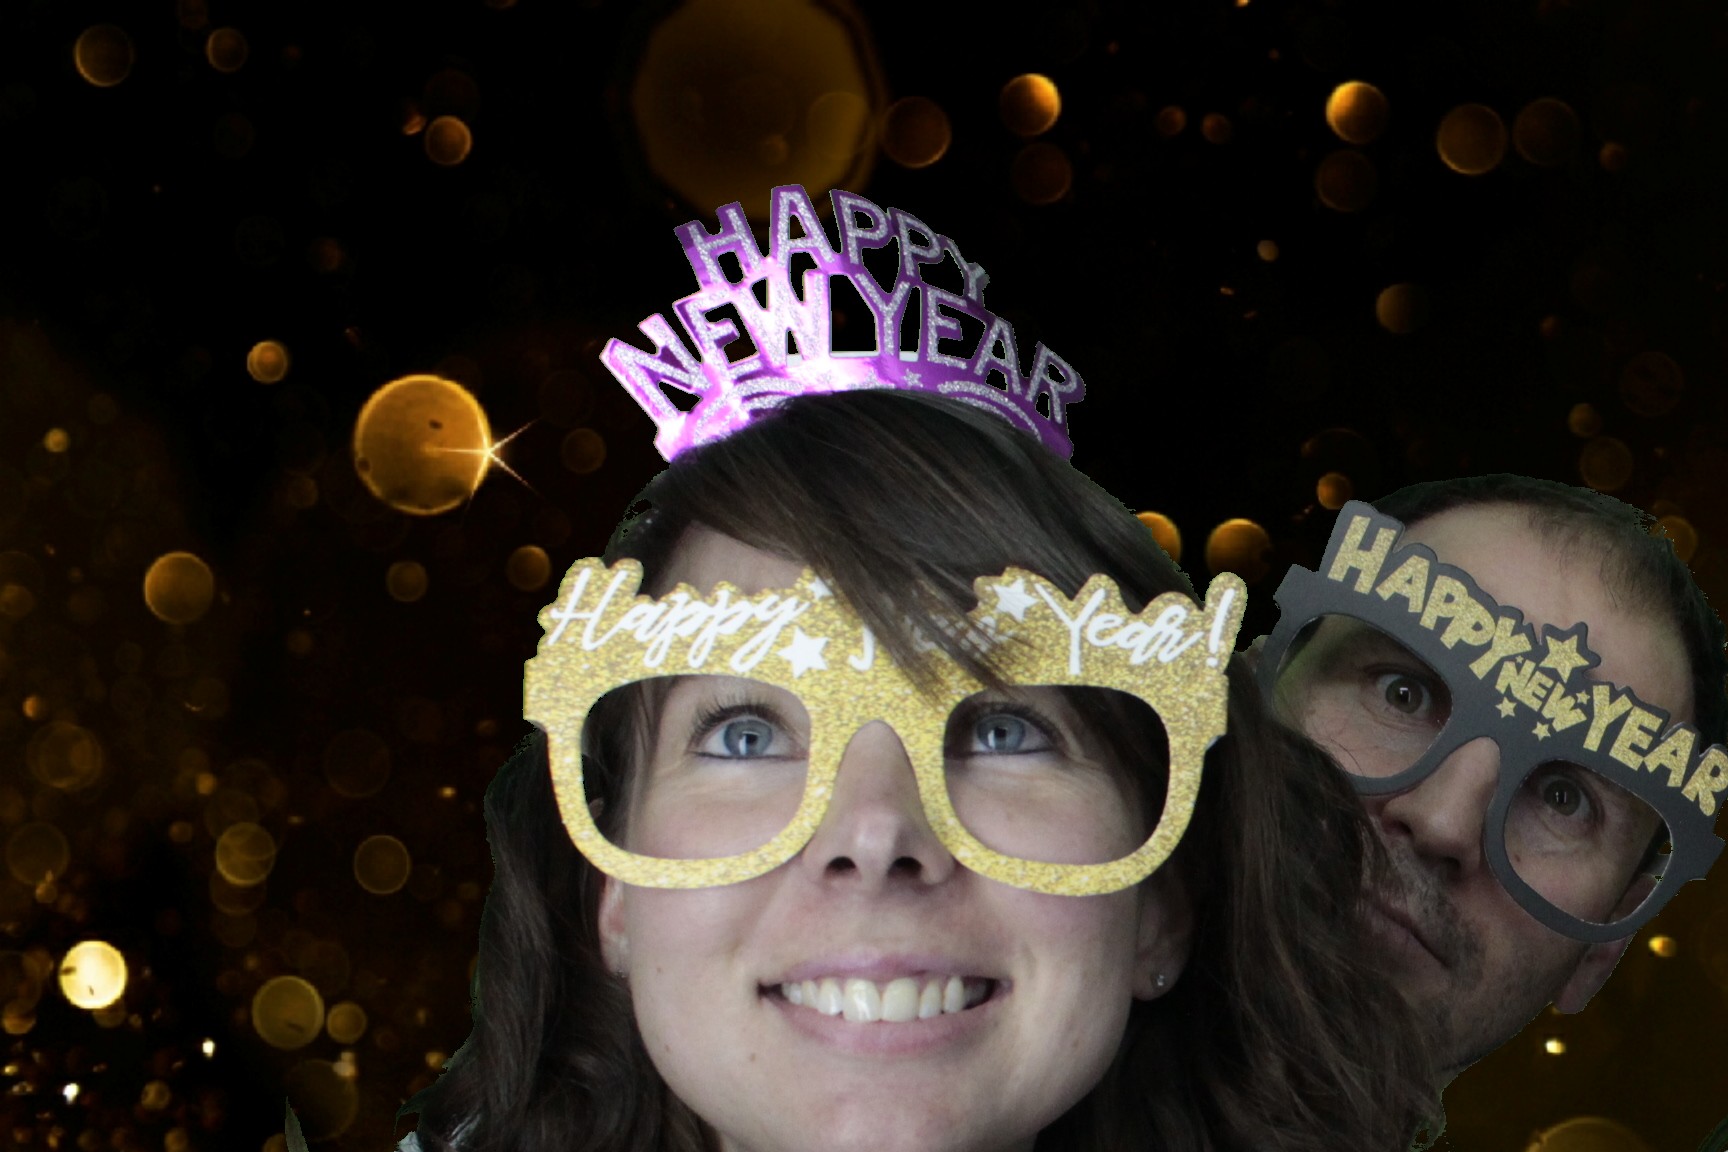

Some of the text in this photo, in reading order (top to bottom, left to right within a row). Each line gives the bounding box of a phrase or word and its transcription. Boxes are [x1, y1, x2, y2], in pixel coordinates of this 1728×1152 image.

[676, 185, 988, 302] HAPPY
[602, 272, 1085, 424] NEW YEAR
[546, 567, 808, 672] Happy
[1035, 584, 1234, 673] Year!
[1328, 515, 1531, 679] HAPPY
[1495, 659, 1586, 733] NEW
